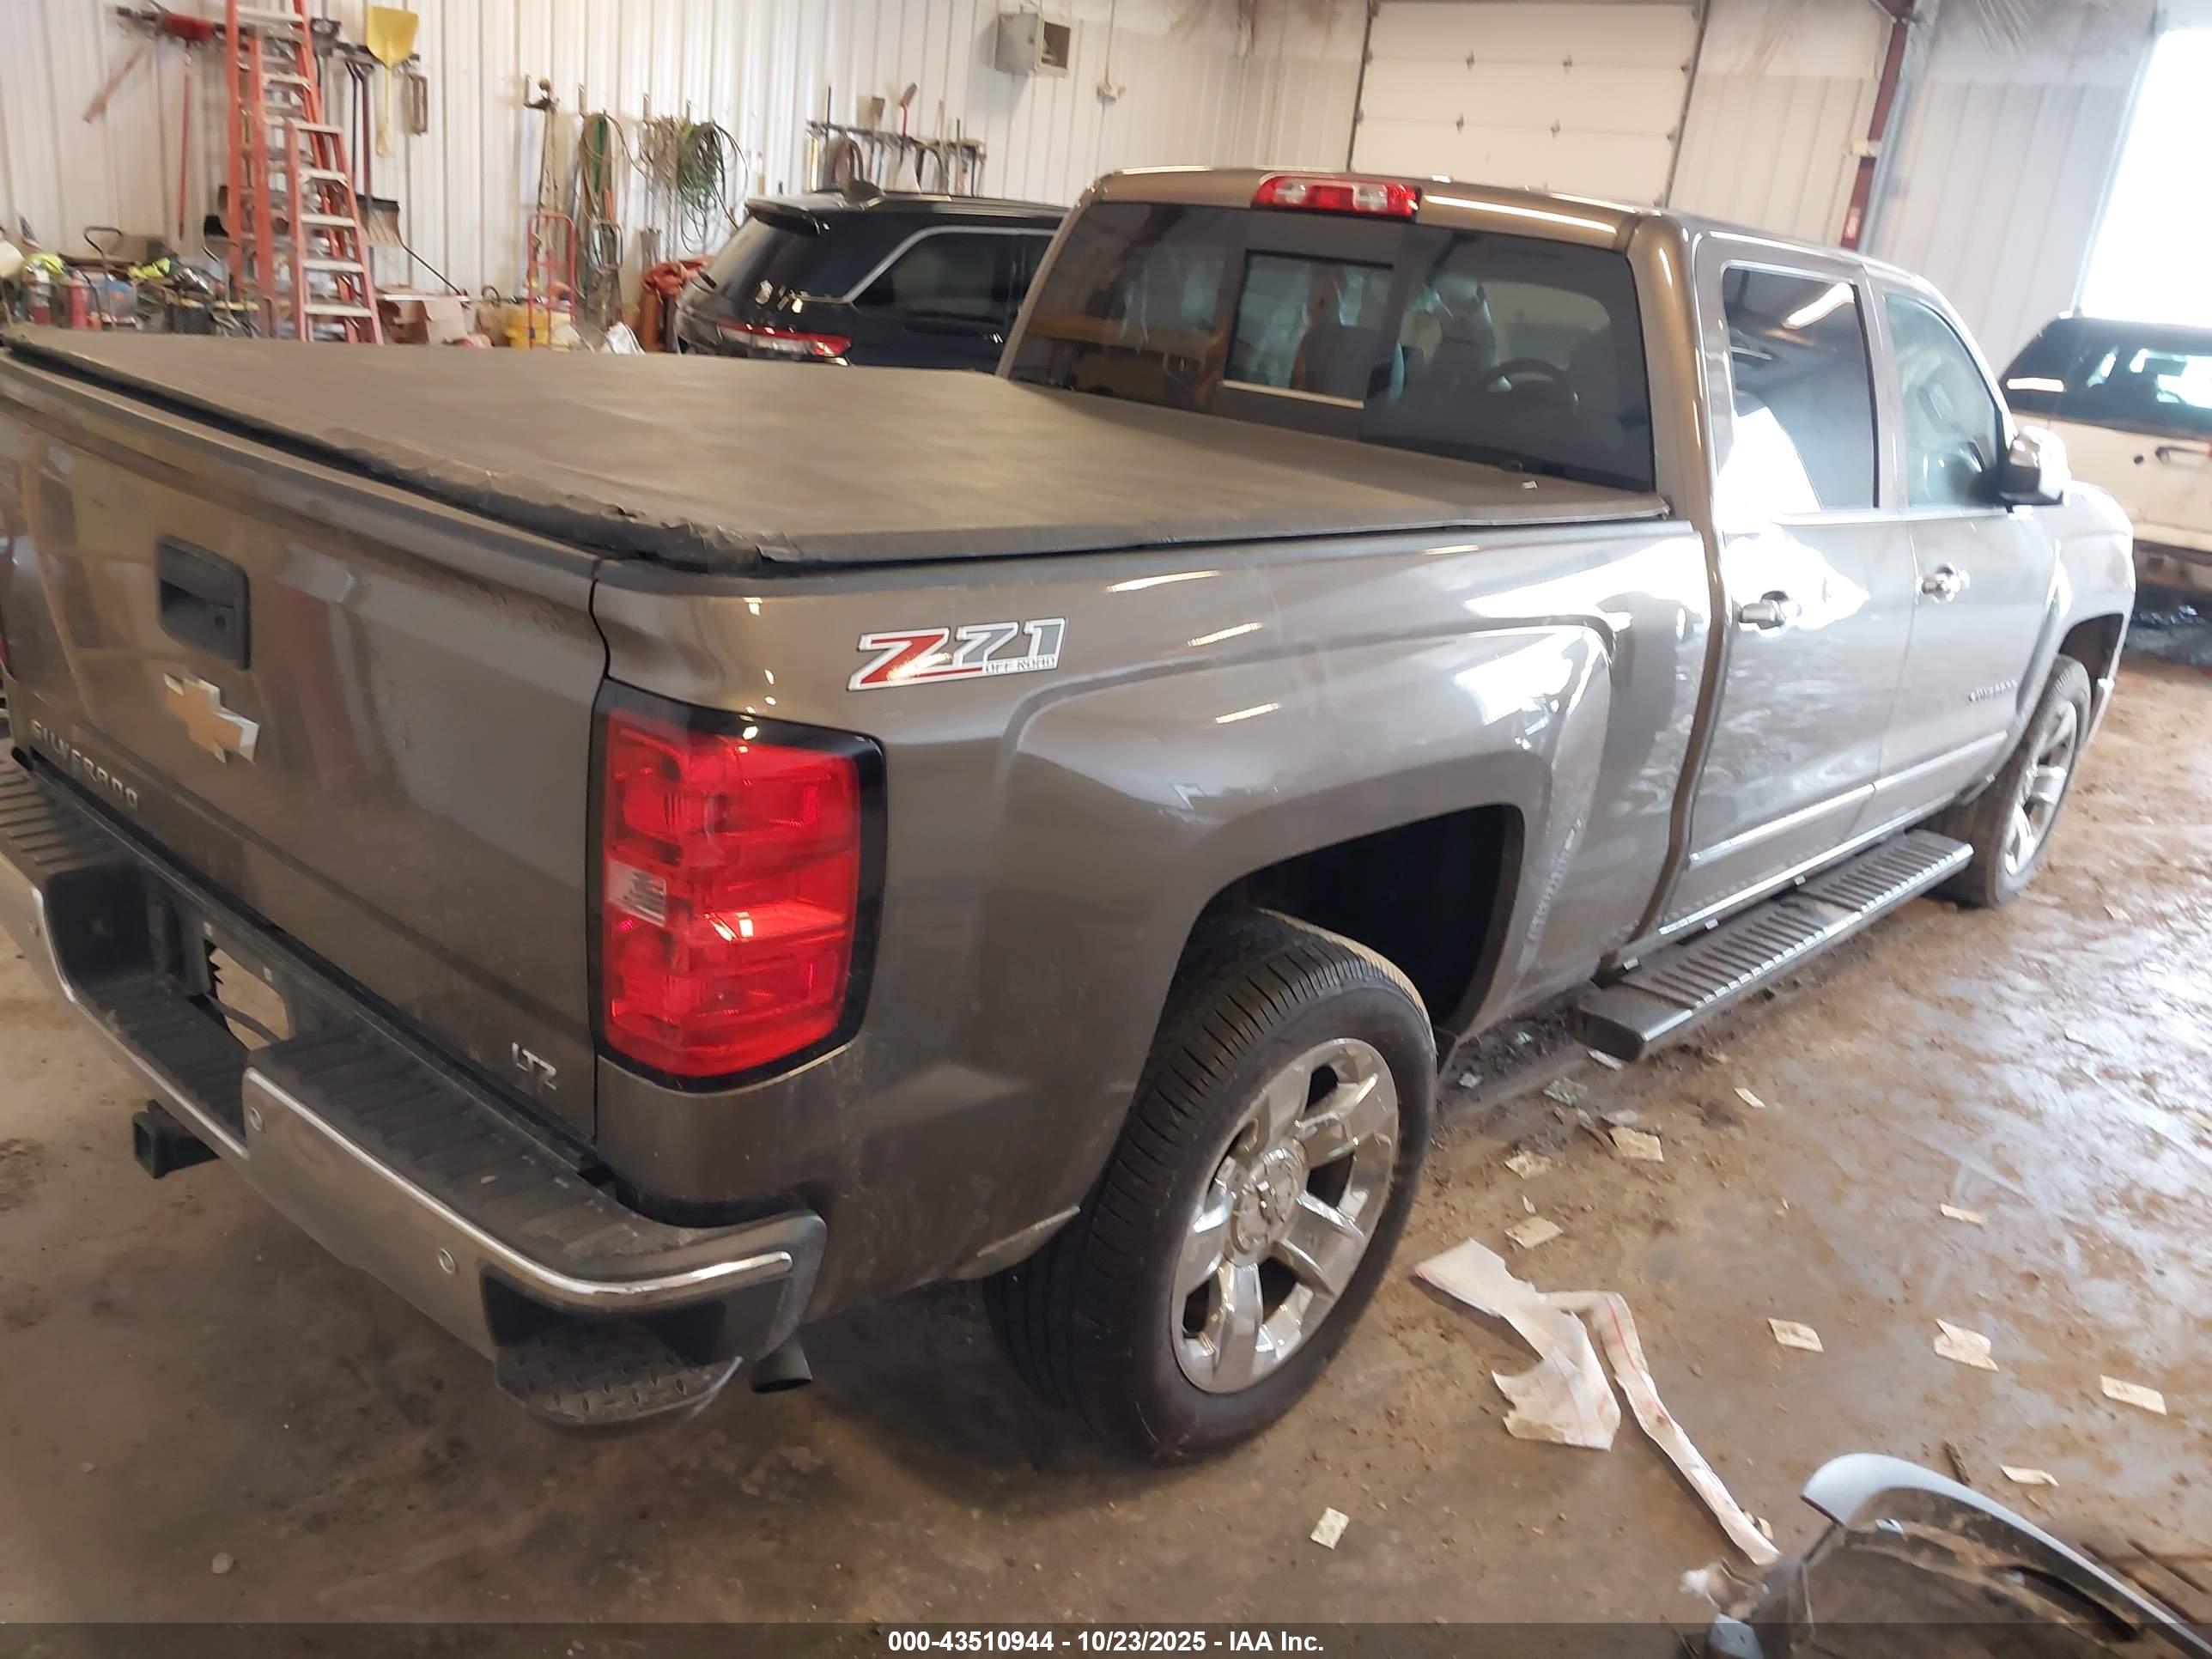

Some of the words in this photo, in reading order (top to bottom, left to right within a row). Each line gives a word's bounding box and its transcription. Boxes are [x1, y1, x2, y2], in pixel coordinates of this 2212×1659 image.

[846, 617, 1066, 692] Z71
[984, 661, 1013, 674] OFF
[31, 719, 138, 810] SILVERADO
[511, 1042, 557, 1091] LTZ
